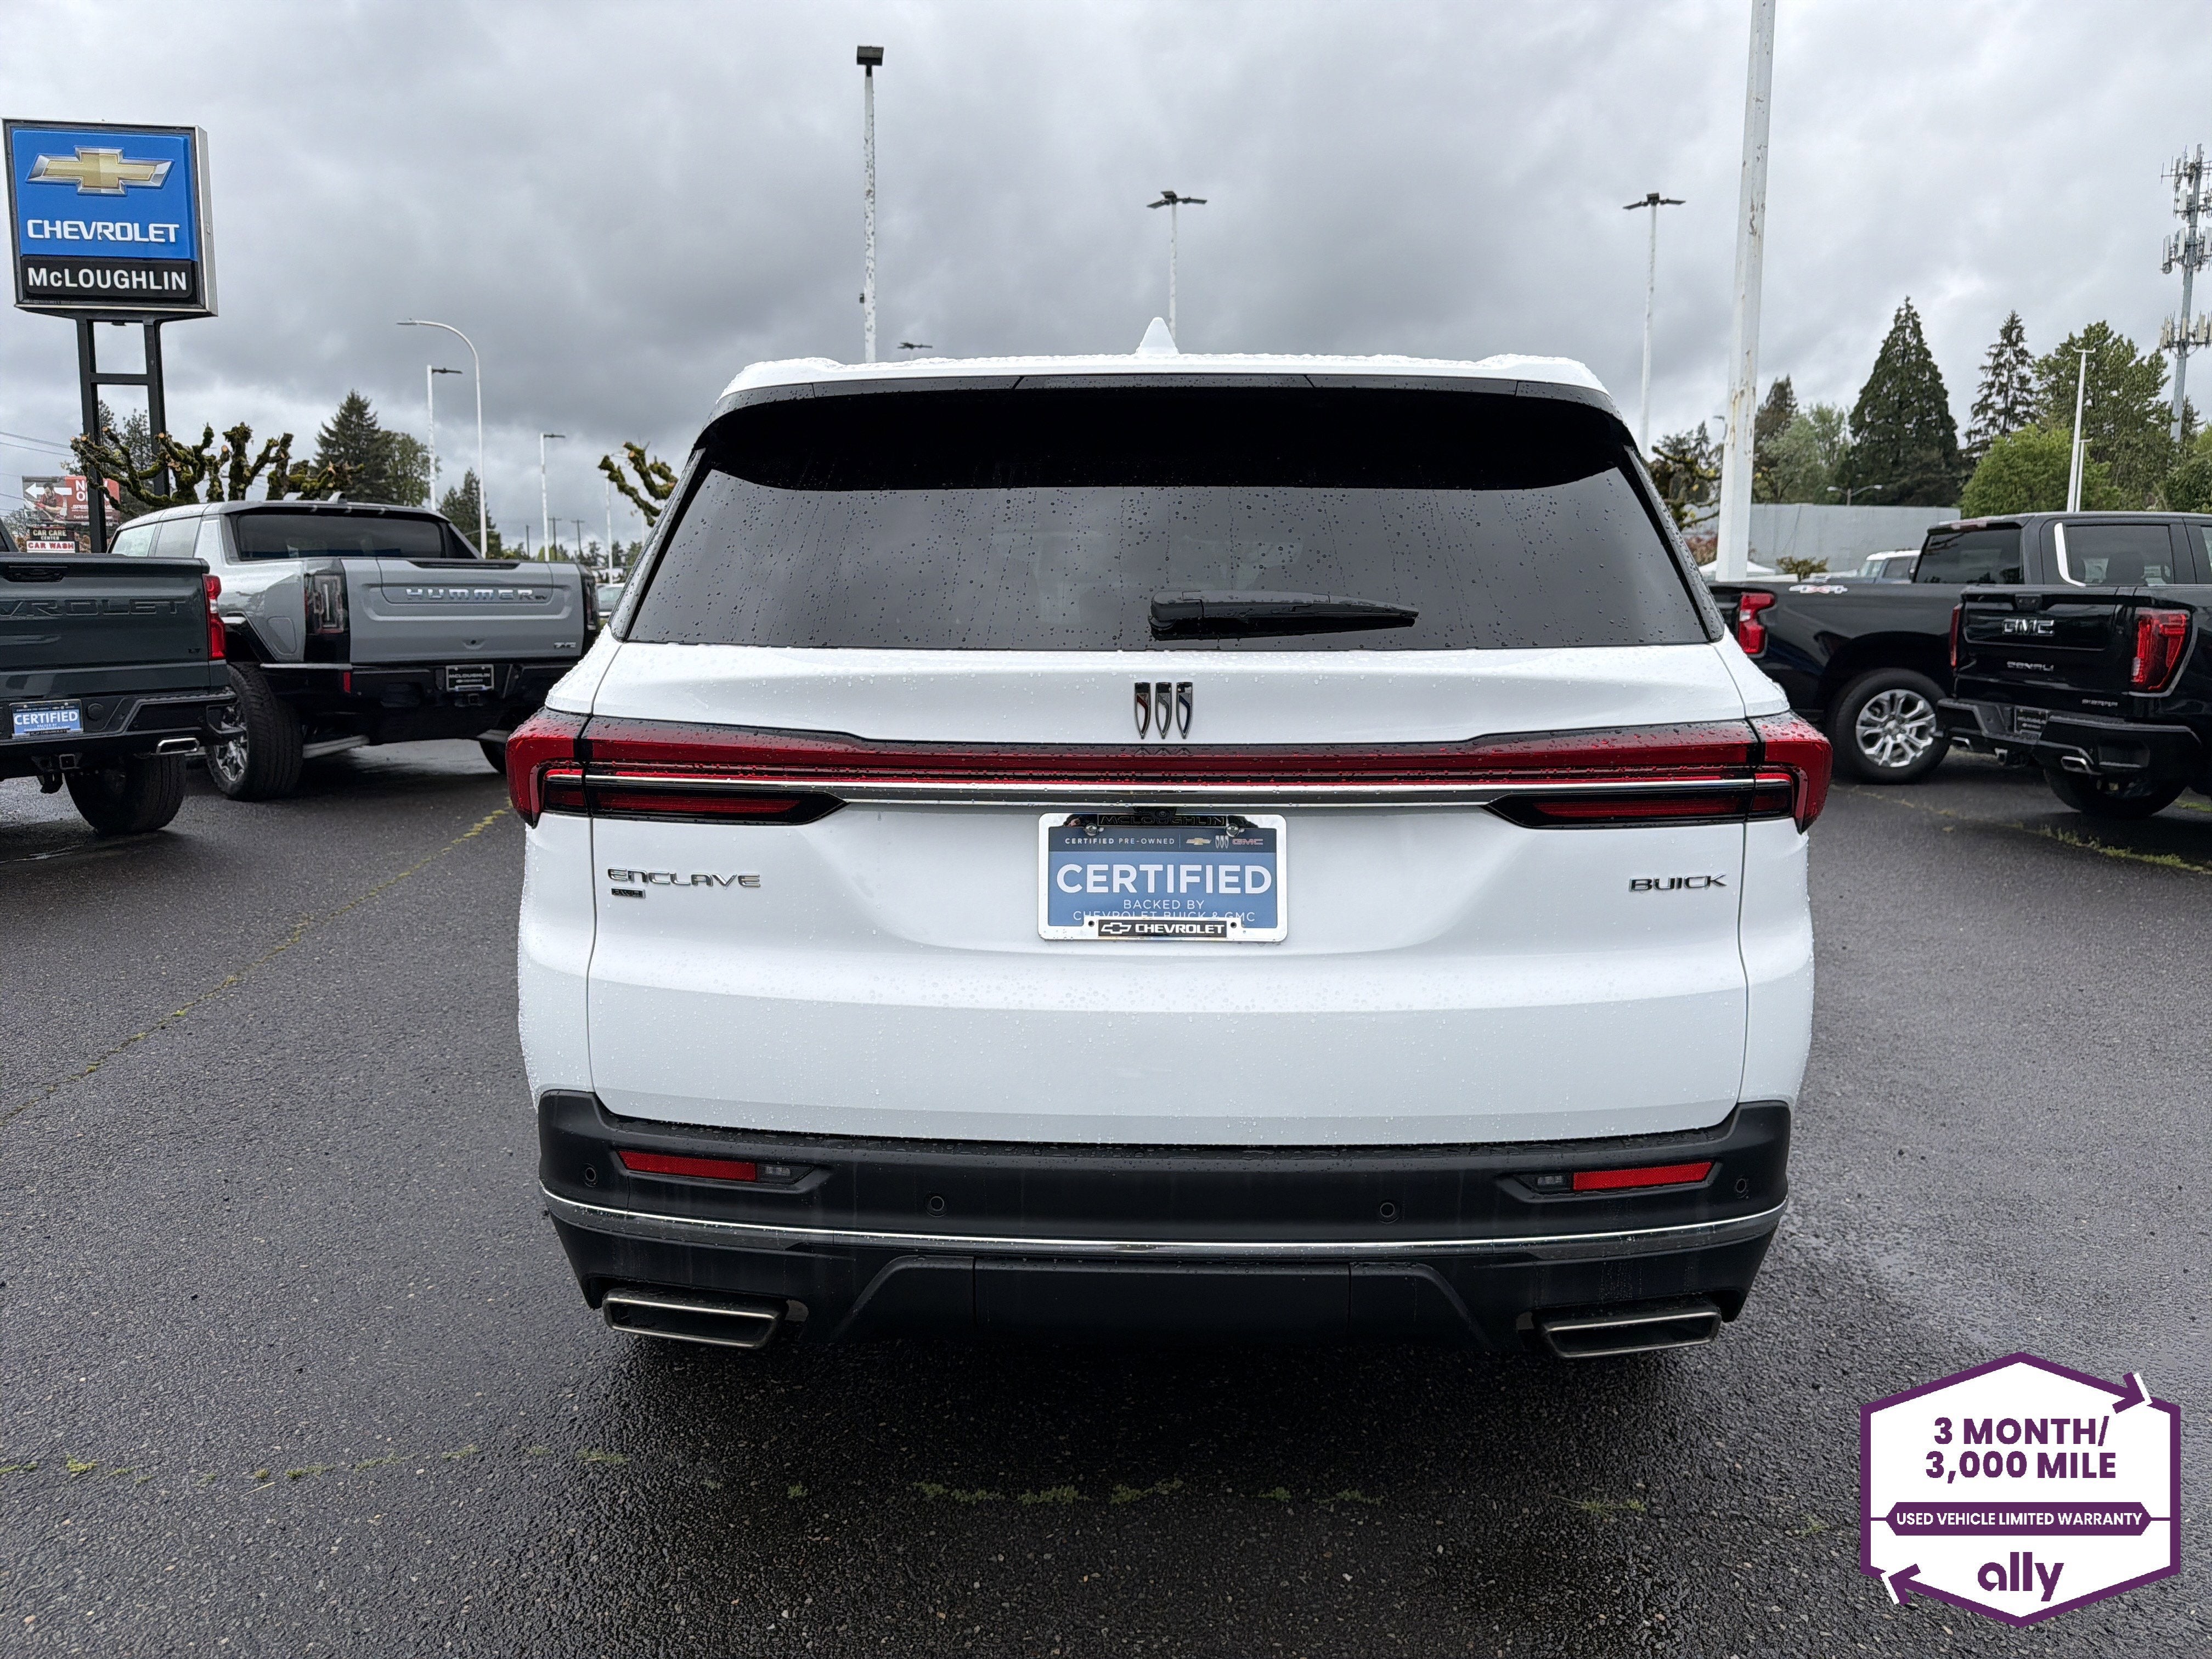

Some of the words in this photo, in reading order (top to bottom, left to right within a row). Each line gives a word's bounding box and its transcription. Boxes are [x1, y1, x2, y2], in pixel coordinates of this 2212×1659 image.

[27, 219, 179, 242] CHEVROLET
[27, 267, 187, 291] McLOUGHLIN
[406, 589, 533, 600] HUMMER
[2003, 618, 2055, 636] GMC
[14, 711, 78, 725] CERTIFIED
[607, 867, 761, 888] ENCLAVE
[1057, 864, 1272, 894] CERTIFIED
[1629, 873, 1727, 891] BUICK
[1124, 900, 1180, 910] BACKED
[1187, 900, 1205, 910] BY
[1135, 924, 1224, 934] CHEVROLET
